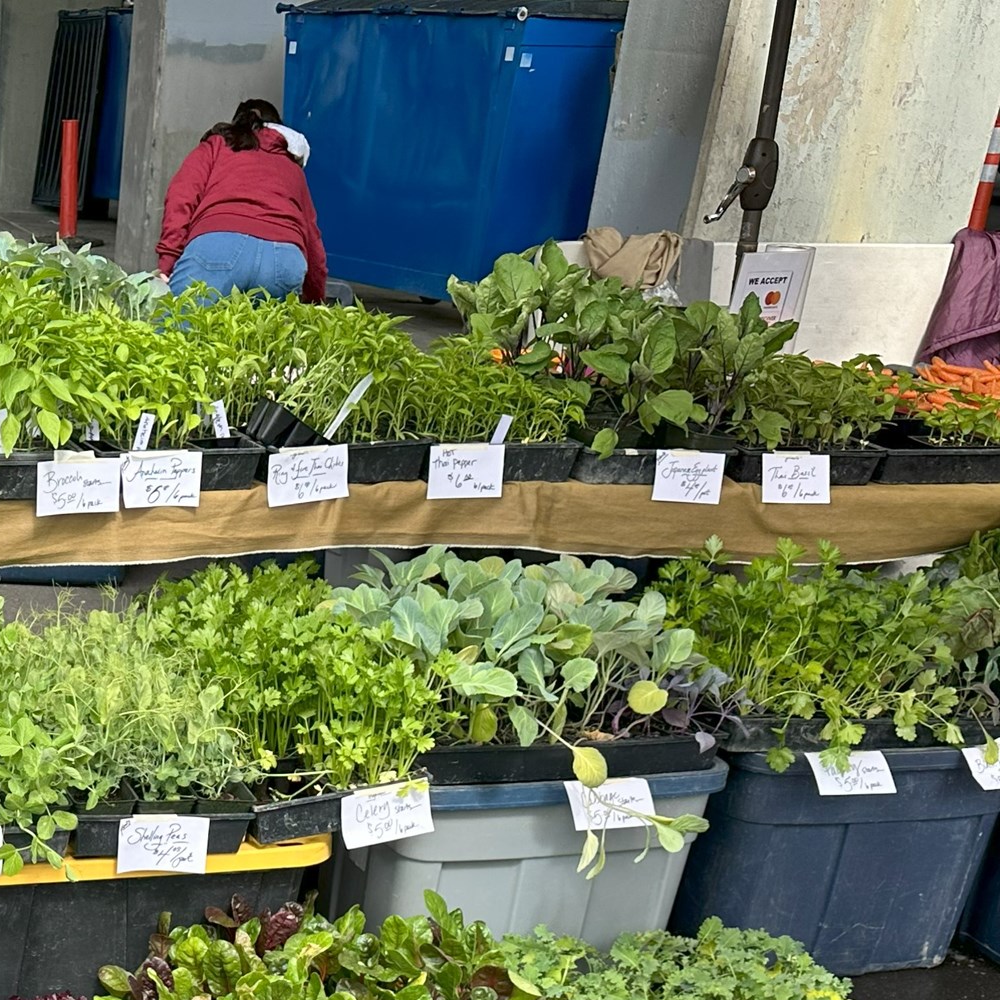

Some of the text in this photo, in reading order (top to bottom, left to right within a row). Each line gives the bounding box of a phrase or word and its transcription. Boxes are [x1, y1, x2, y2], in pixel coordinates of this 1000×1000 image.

[748, 276, 788, 285] WE ACCEPT
[767, 464, 816, 482] Thai Basil
[356, 801, 390, 823] Celery
[166, 822, 188, 843] Peas
